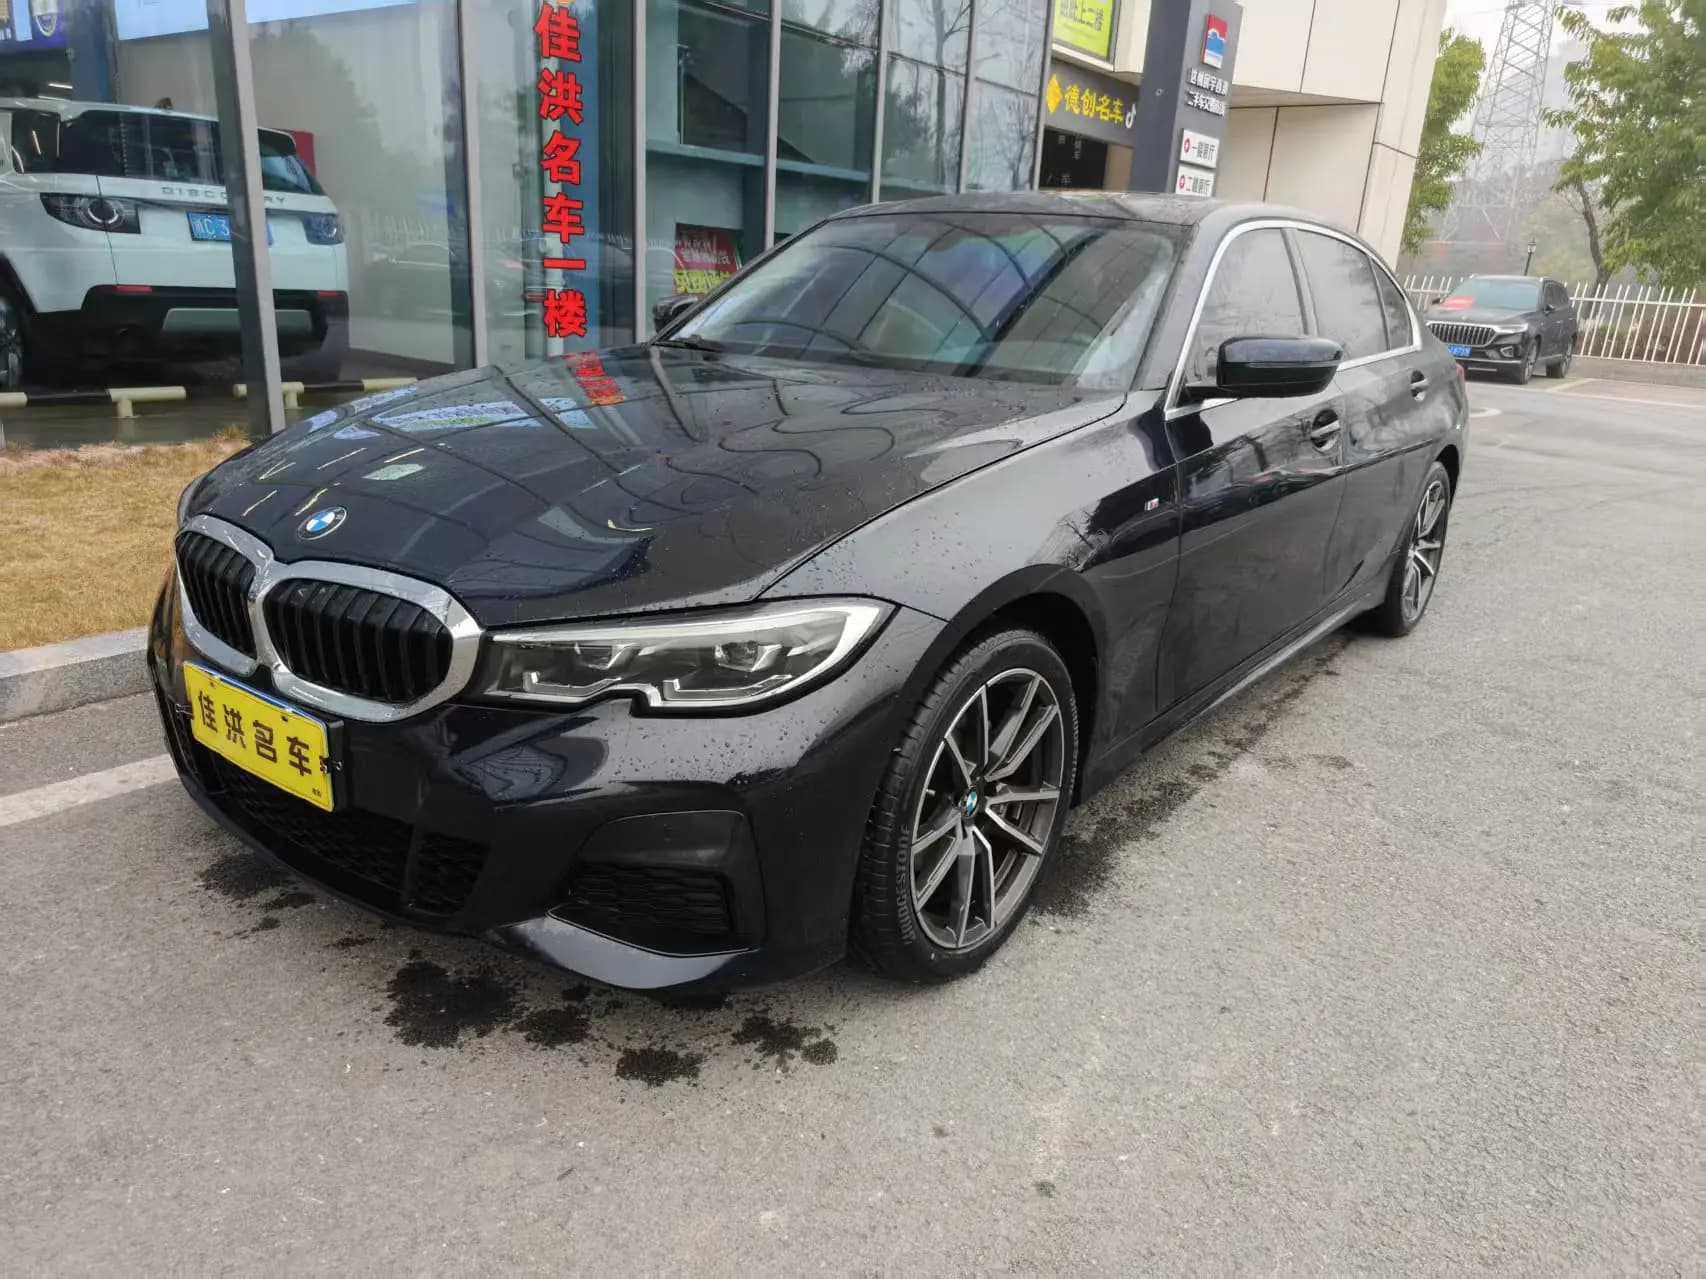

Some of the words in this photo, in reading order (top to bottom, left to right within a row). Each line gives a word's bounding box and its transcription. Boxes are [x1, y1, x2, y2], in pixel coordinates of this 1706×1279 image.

[1064, 84, 1124, 124] 德创名车
[533, 4, 587, 338] 佳洪名车一楼
[198, 690, 312, 777] 佳洪名车
